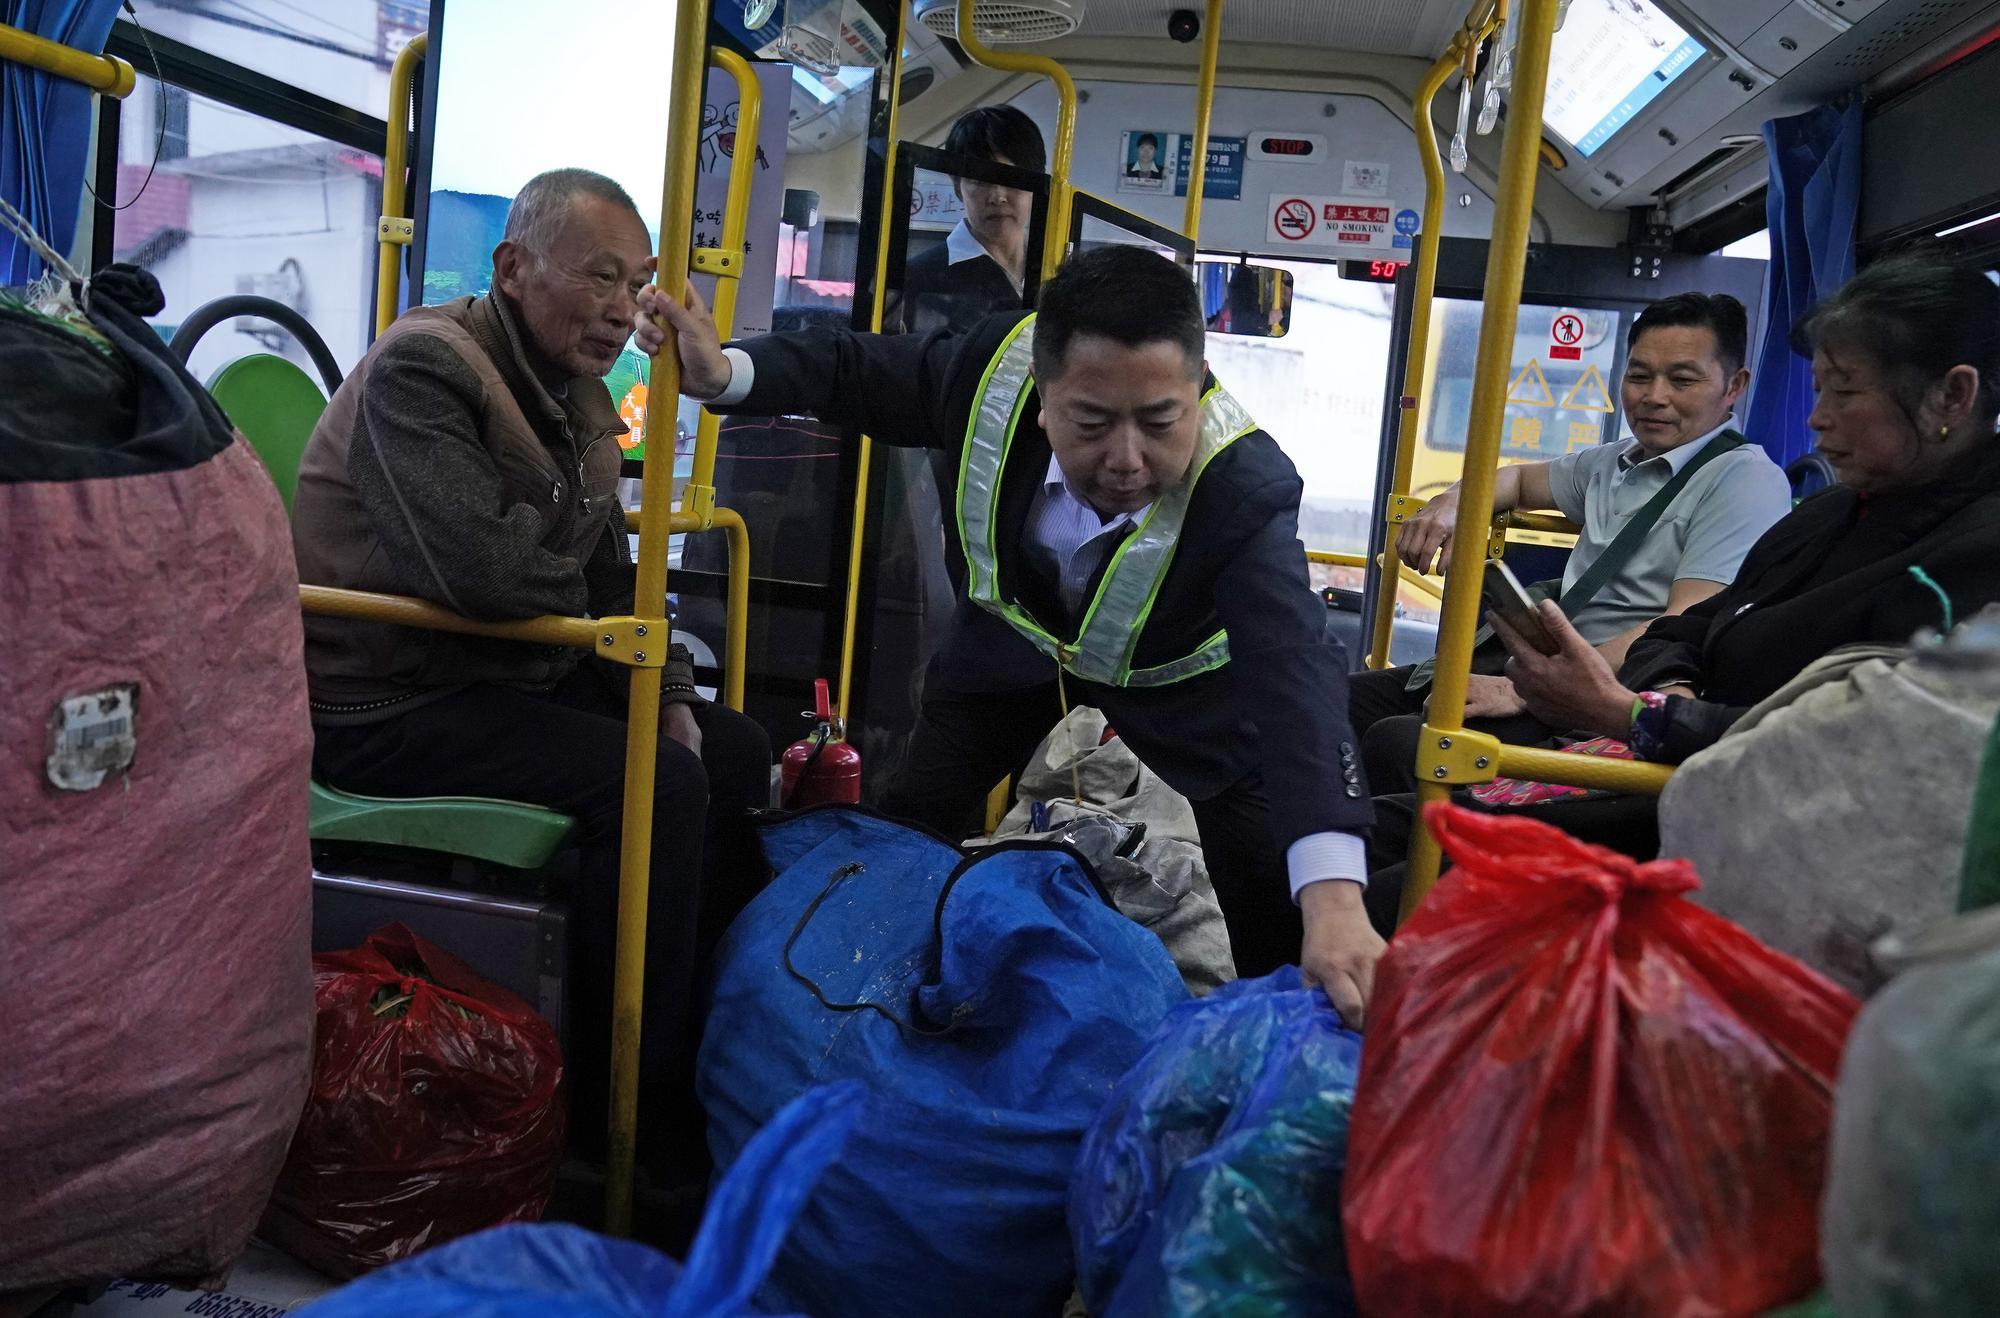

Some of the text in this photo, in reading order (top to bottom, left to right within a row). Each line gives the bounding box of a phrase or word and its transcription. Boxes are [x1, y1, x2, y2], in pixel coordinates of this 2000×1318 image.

[1270, 140, 1305, 153] STOP
[1326, 206, 1388, 222] 禁止吸烟
[1326, 222, 1385, 233] NO SMOKING
